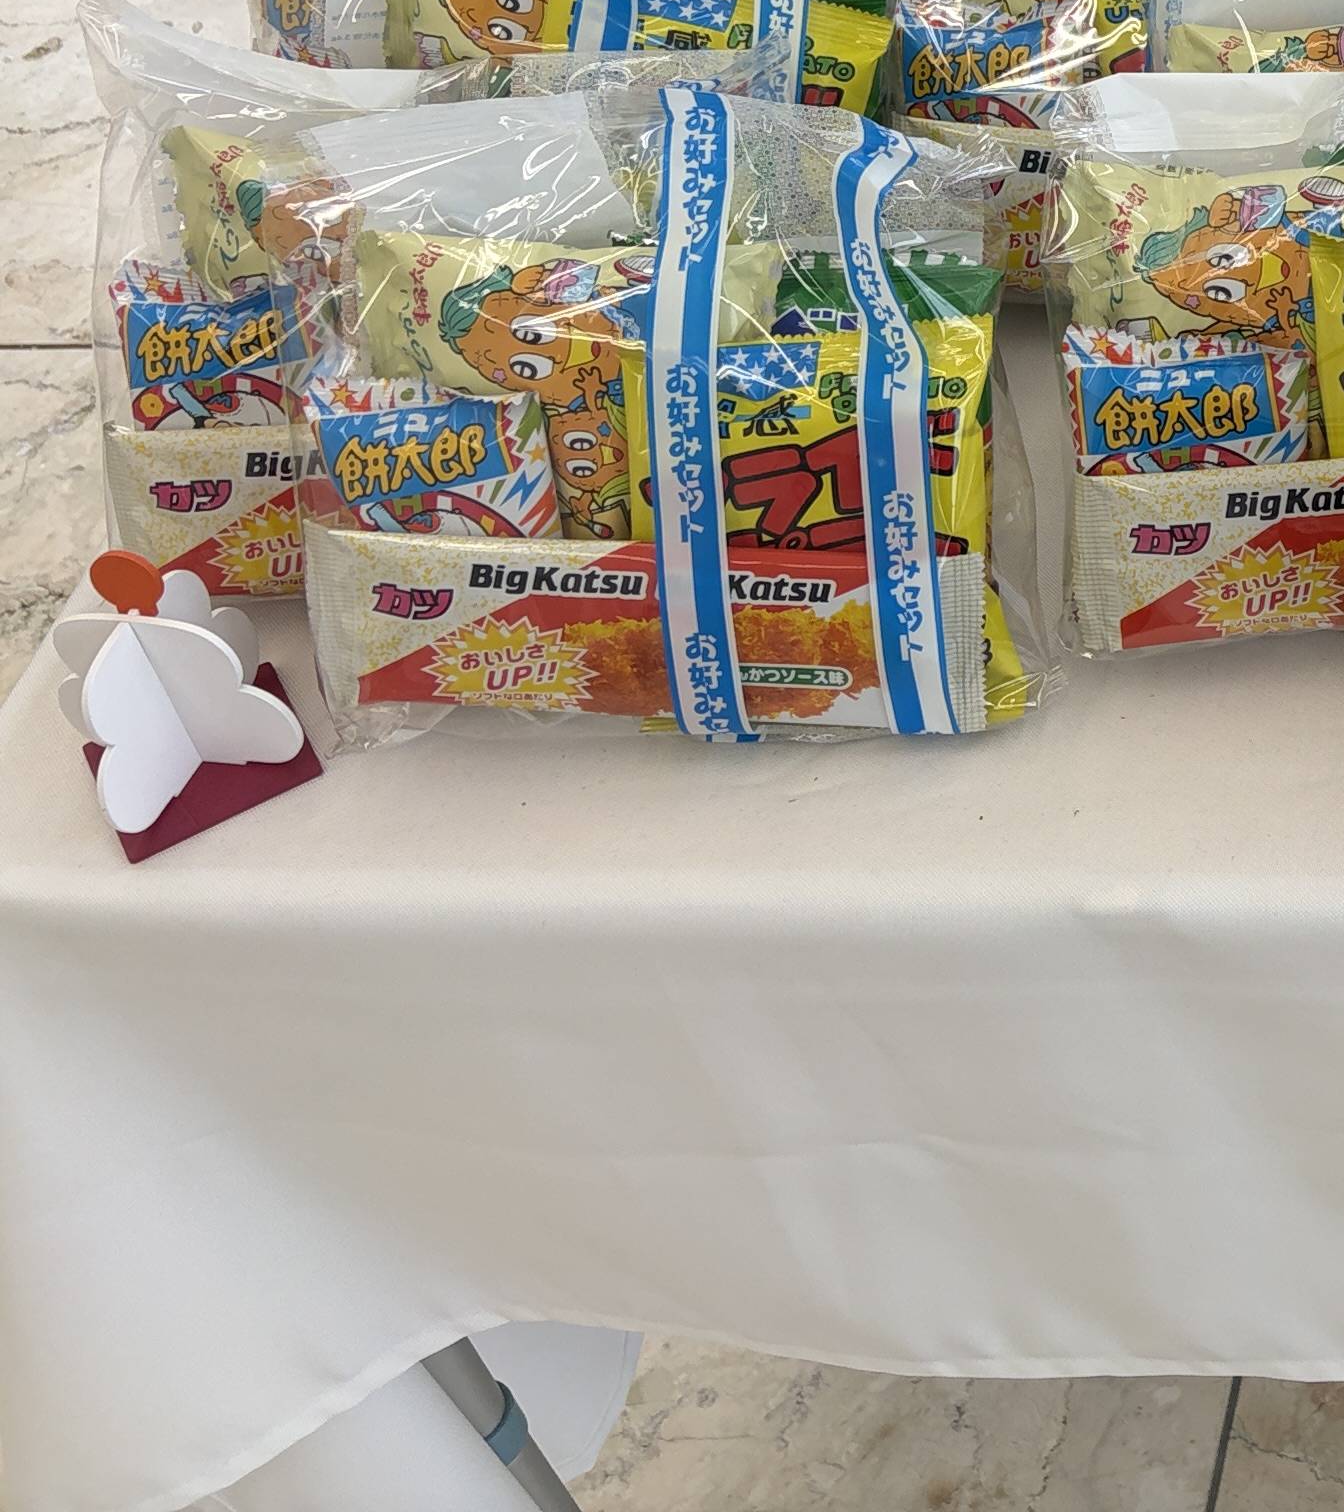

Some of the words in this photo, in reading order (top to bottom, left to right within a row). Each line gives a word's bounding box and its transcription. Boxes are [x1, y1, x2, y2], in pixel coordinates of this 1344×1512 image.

[136, 309, 291, 383] 餅太郎
[1135, 368, 1216, 393] ニュー
[1094, 383, 1260, 451] 餅太郎
[333, 423, 488, 503] 餅太郎
[665, 364, 705, 543] お好みセット
[149, 478, 233, 514] カツ
[1130, 522, 1212, 556] カツ
[882, 489, 927, 665] お好みセット
[1219, 566, 1302, 602] おいしさ
[373, 581, 455, 620] カツ
[1244, 582, 1313, 619] UP!!
[458, 642, 547, 671] おいしさ
[487, 659, 557, 691] UP!!
